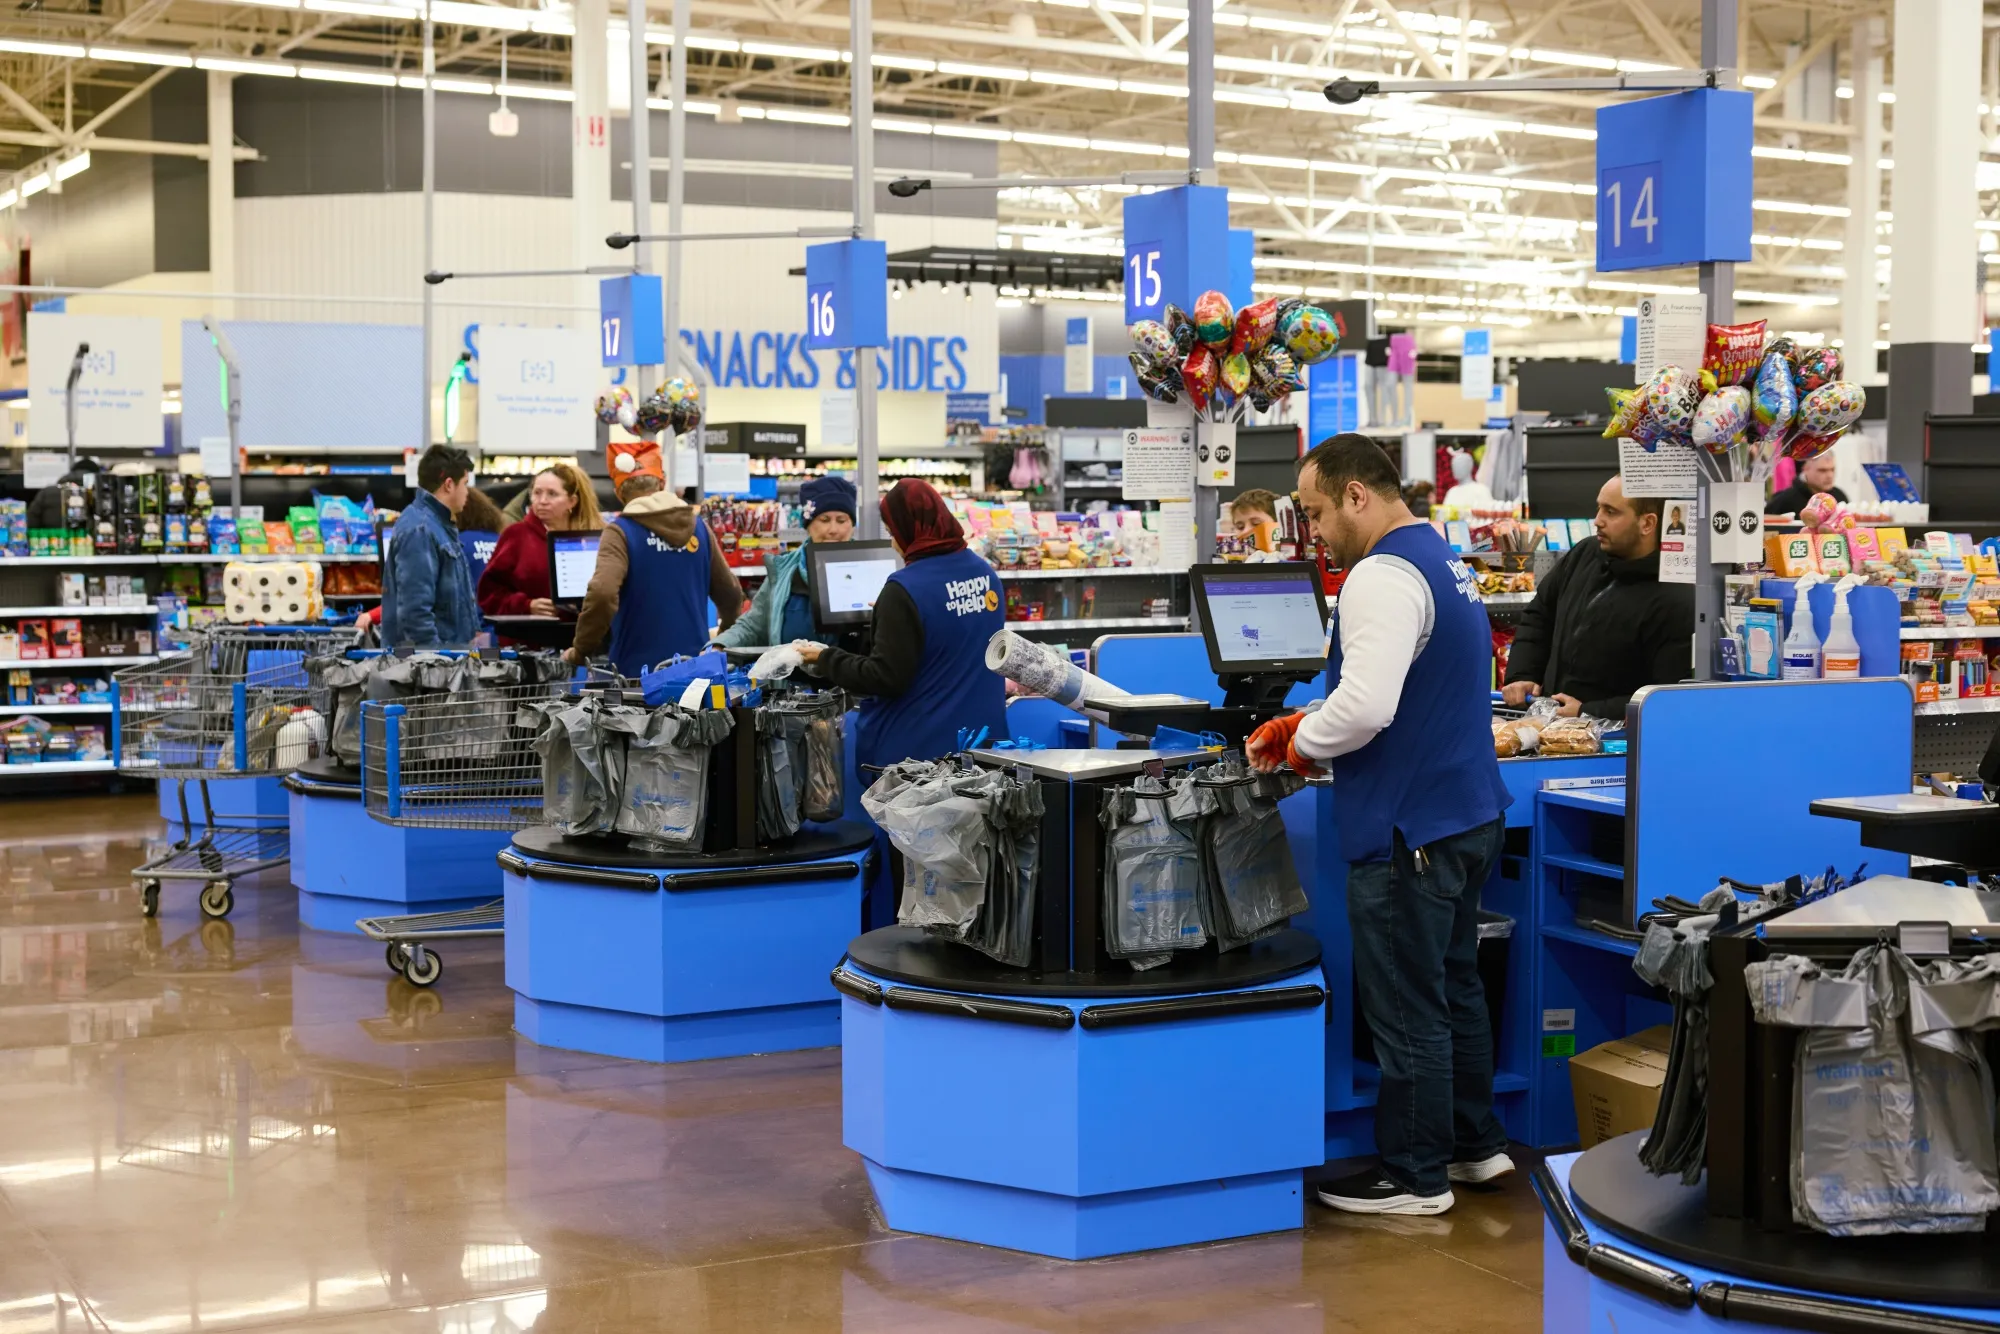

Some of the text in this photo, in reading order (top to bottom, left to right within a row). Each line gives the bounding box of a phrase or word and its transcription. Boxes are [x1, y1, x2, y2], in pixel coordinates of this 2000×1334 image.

[1606, 177, 1659, 248] 14
[1130, 251, 1162, 307] 15
[810, 291, 835, 337] 16
[603, 318, 620, 356] 17
[1727, 333, 1762, 350] HAPPY
[1140, 435, 1170, 443] WARNING
[1791, 549, 1807, 557] tac
[1793, 541, 1807, 550] tic
[1824, 549, 1840, 557] tac
[1826, 541, 1840, 550] tic
[945, 575, 989, 600] Happy
[945, 593, 986, 616] to Help
[1816, 1061, 1895, 1080] Walmart
